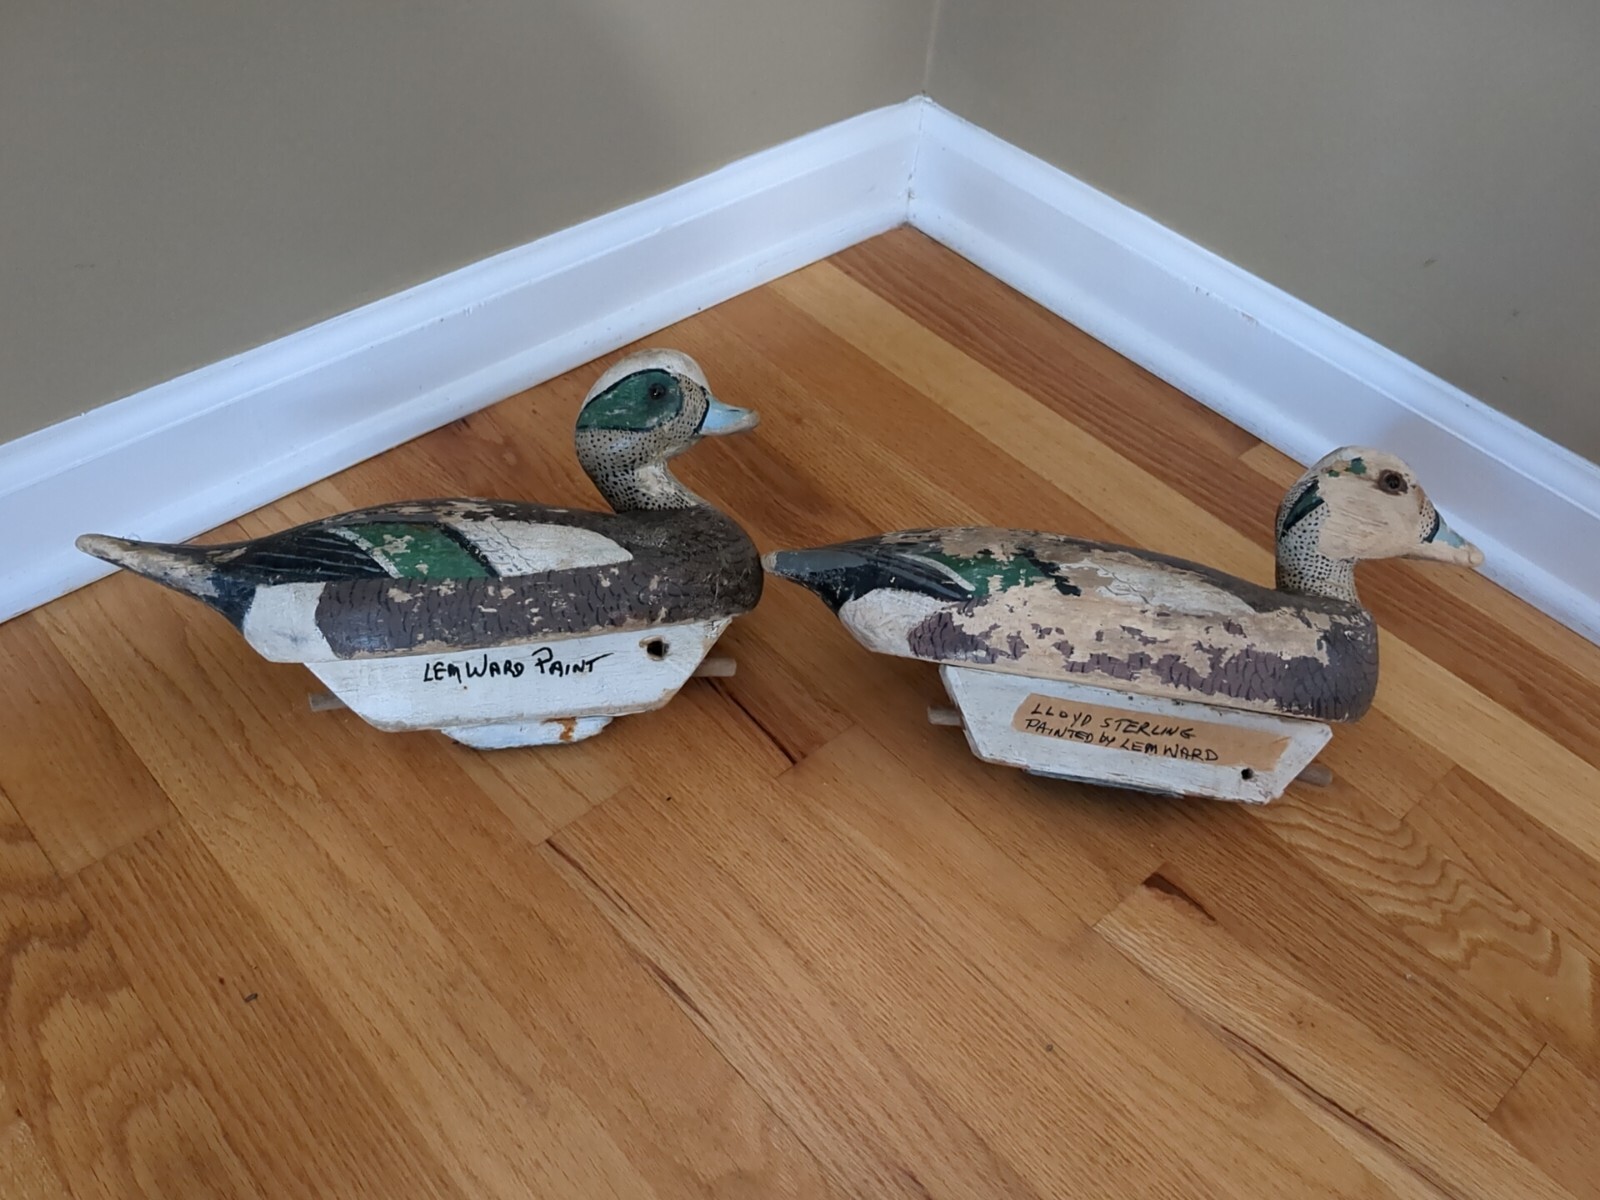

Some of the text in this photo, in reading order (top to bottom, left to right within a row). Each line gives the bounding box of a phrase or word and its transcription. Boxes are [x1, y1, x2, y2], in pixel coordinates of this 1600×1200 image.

[423, 661, 462, 684] LEM
[465, 653, 525, 678] WARD
[1030, 703, 1197, 739] LLOYD STERLING
[1024, 718, 1095, 743] PAINTED
[1120, 738, 1158, 755] LEM
[1163, 743, 1219, 762] WARD
